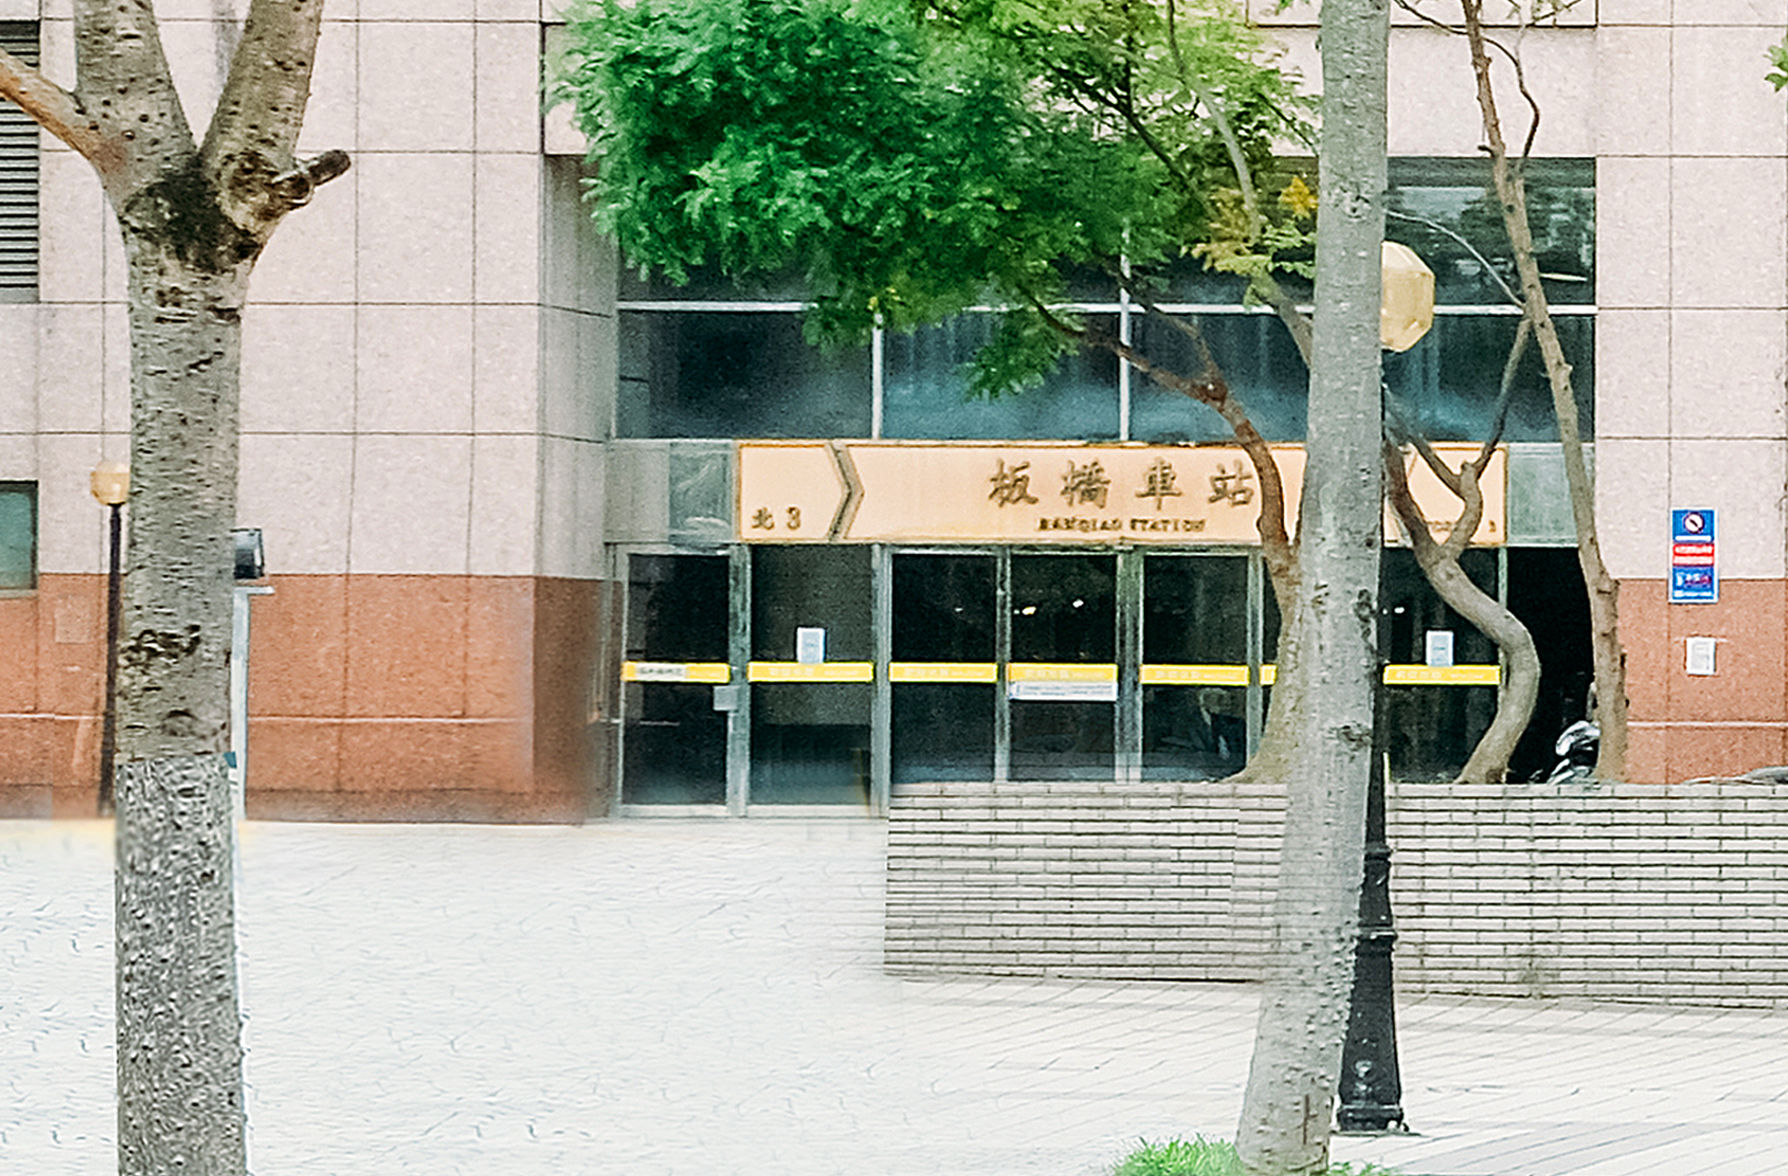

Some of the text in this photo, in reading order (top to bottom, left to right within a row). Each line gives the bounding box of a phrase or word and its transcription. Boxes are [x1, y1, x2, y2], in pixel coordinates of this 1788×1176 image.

[987, 457, 1255, 511] 板橋車站
[1129, 517, 1206, 533] STATION
